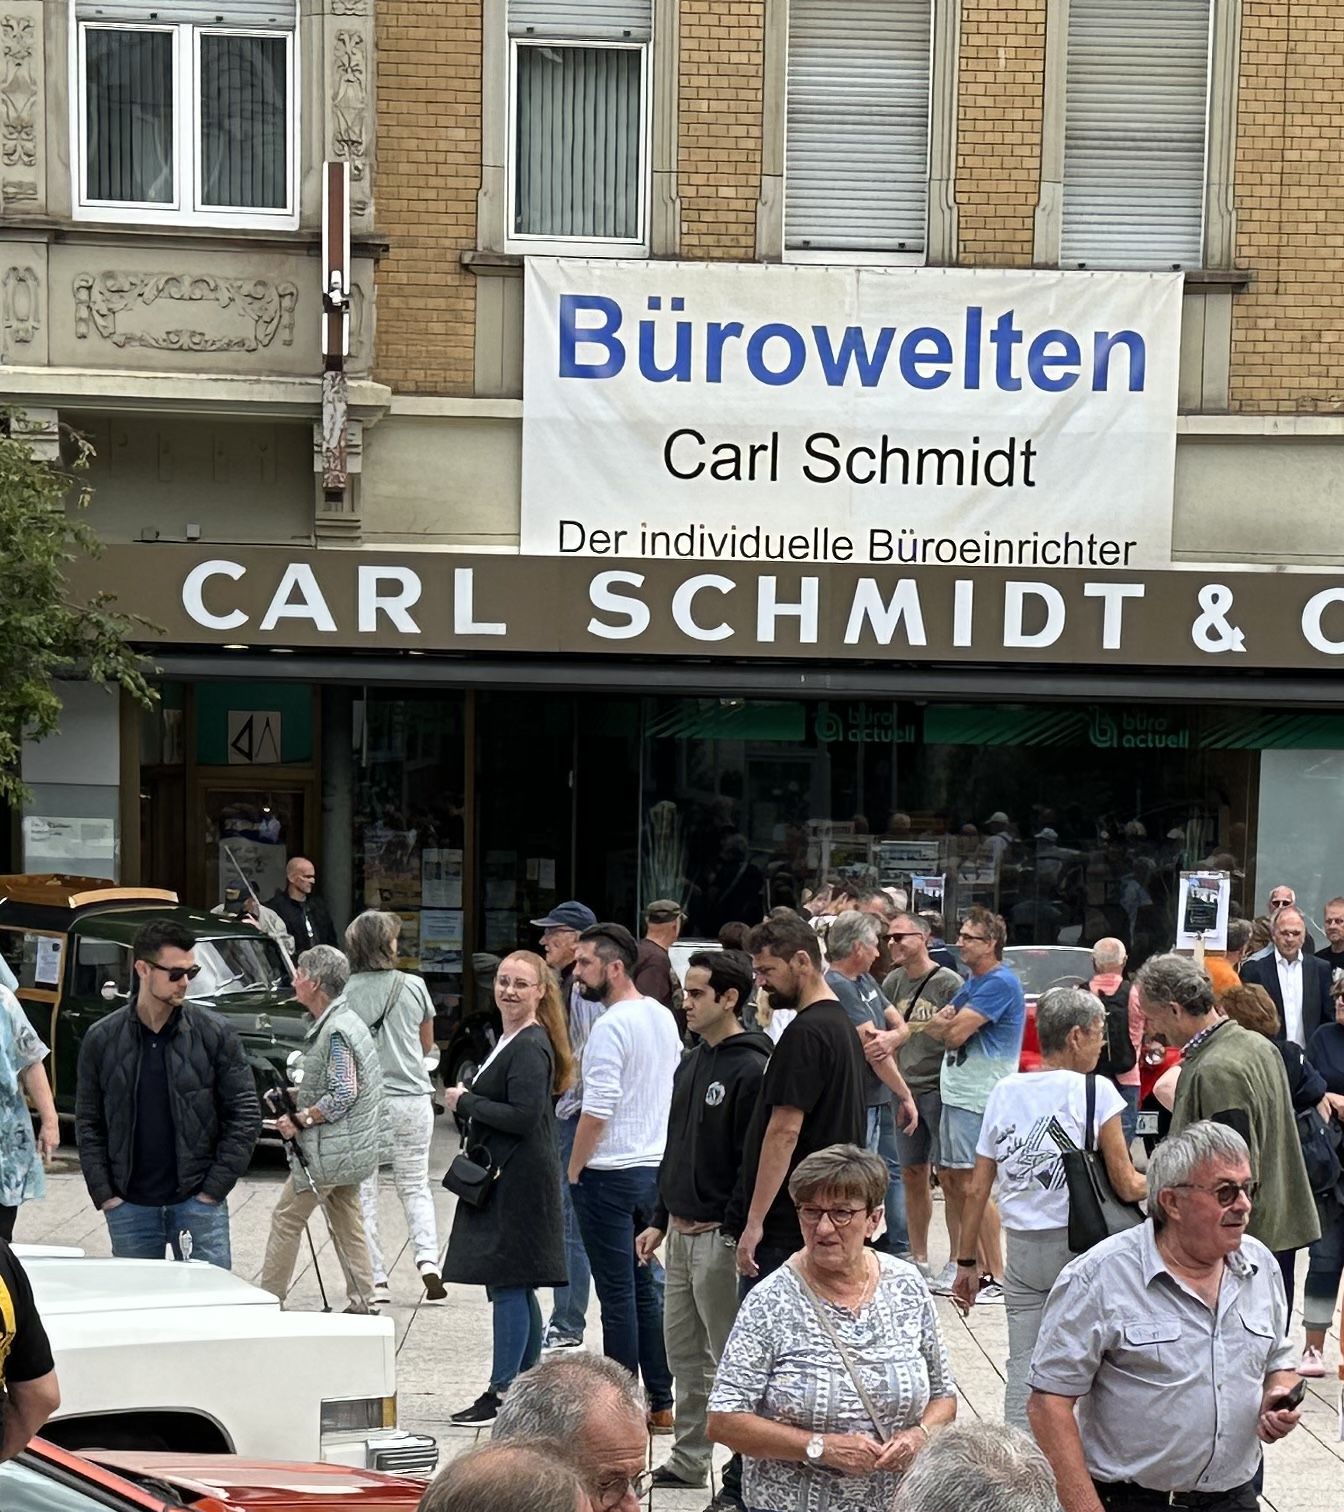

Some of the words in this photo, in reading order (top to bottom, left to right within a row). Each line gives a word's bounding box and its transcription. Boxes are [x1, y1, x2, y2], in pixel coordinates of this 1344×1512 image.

[558, 294, 1147, 392] Bürowelten
[663, 428, 780, 483] Carl
[802, 431, 1038, 488] Schmidt
[559, 520, 628, 556] Der
[641, 523, 854, 562] individuelle
[869, 526, 1138, 567] Büroeinrichter
[182, 559, 508, 637] CARL
[587, 570, 1147, 650] SCHMIDT
[1191, 583, 1248, 654] &
[1122, 712, 1168, 731] büro
[1122, 730, 1189, 749] actuell
